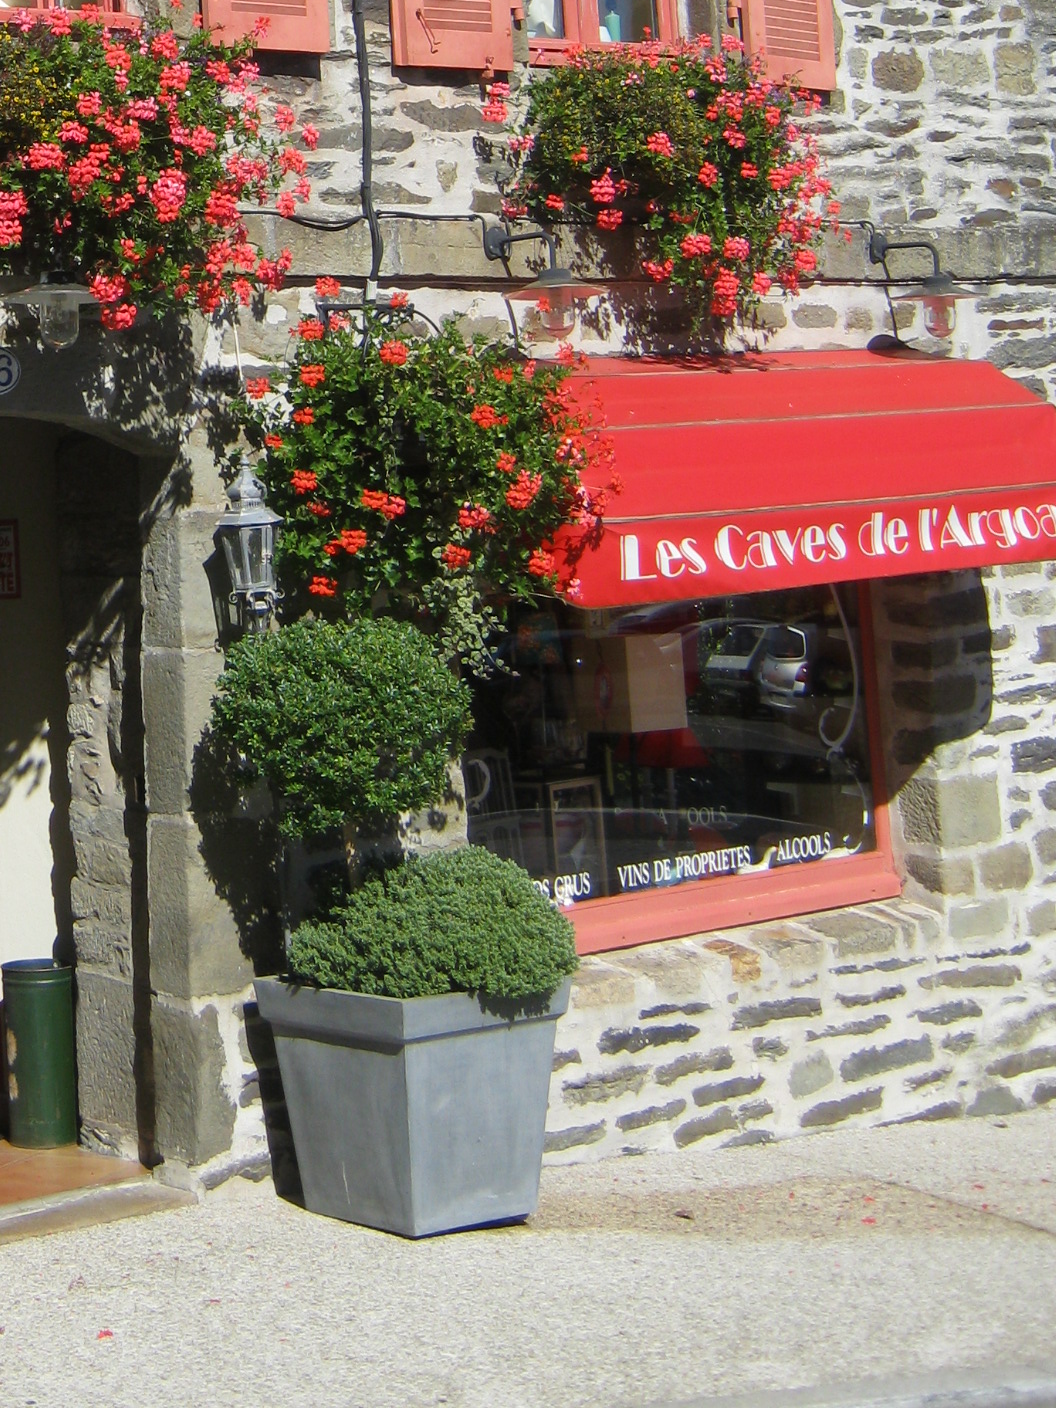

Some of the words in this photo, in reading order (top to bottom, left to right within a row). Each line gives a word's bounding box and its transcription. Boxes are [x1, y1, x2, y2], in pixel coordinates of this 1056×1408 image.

[619, 533, 708, 581] Les
[713, 522, 848, 571] Caves
[857, 510, 910, 557] de
[918, 503, 1056, 552] l'Argoa
[616, 861, 651, 889] VINS
[653, 858, 672, 883] DE
[674, 844, 752, 879] PROPRIETES
[775, 830, 831, 863] ALCOOLS
